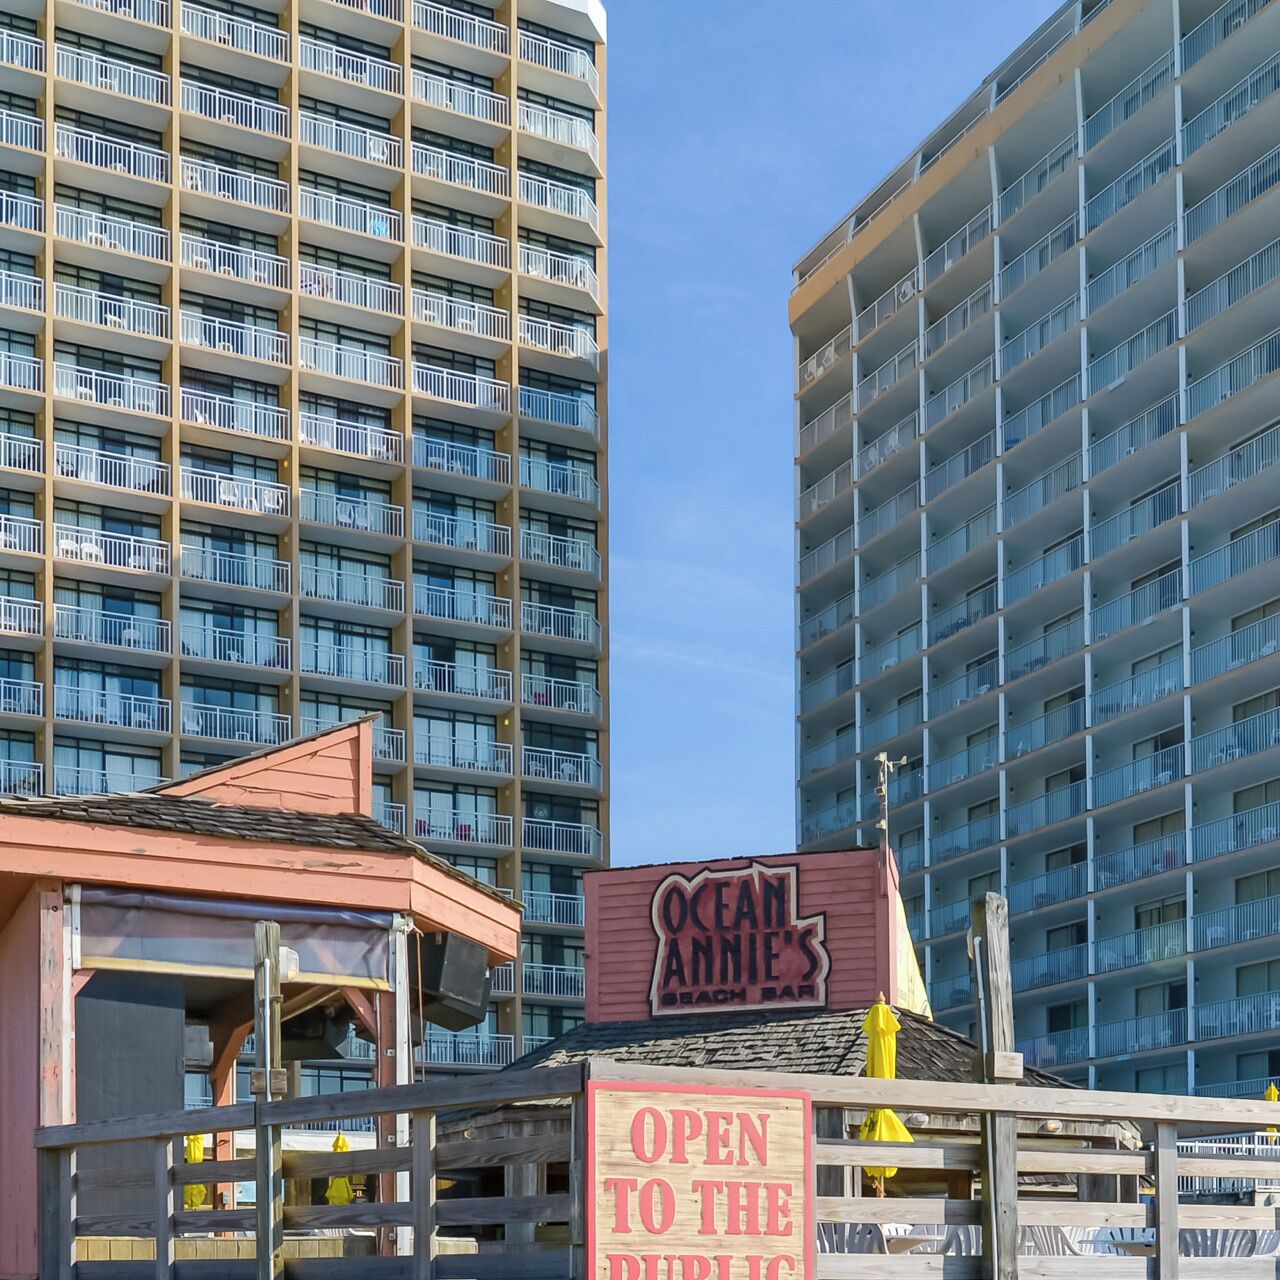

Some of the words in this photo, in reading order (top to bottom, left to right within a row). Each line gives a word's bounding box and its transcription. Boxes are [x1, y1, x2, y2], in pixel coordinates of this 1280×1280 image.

[663, 877, 785, 934] OCEAN
[664, 928, 818, 986] ANNIE'S
[663, 988, 746, 1006] BEACH
[761, 984, 816, 999] BAR
[630, 1107, 770, 1166] OPEN
[604, 1178, 676, 1235] TO
[692, 1180, 793, 1236] THE
